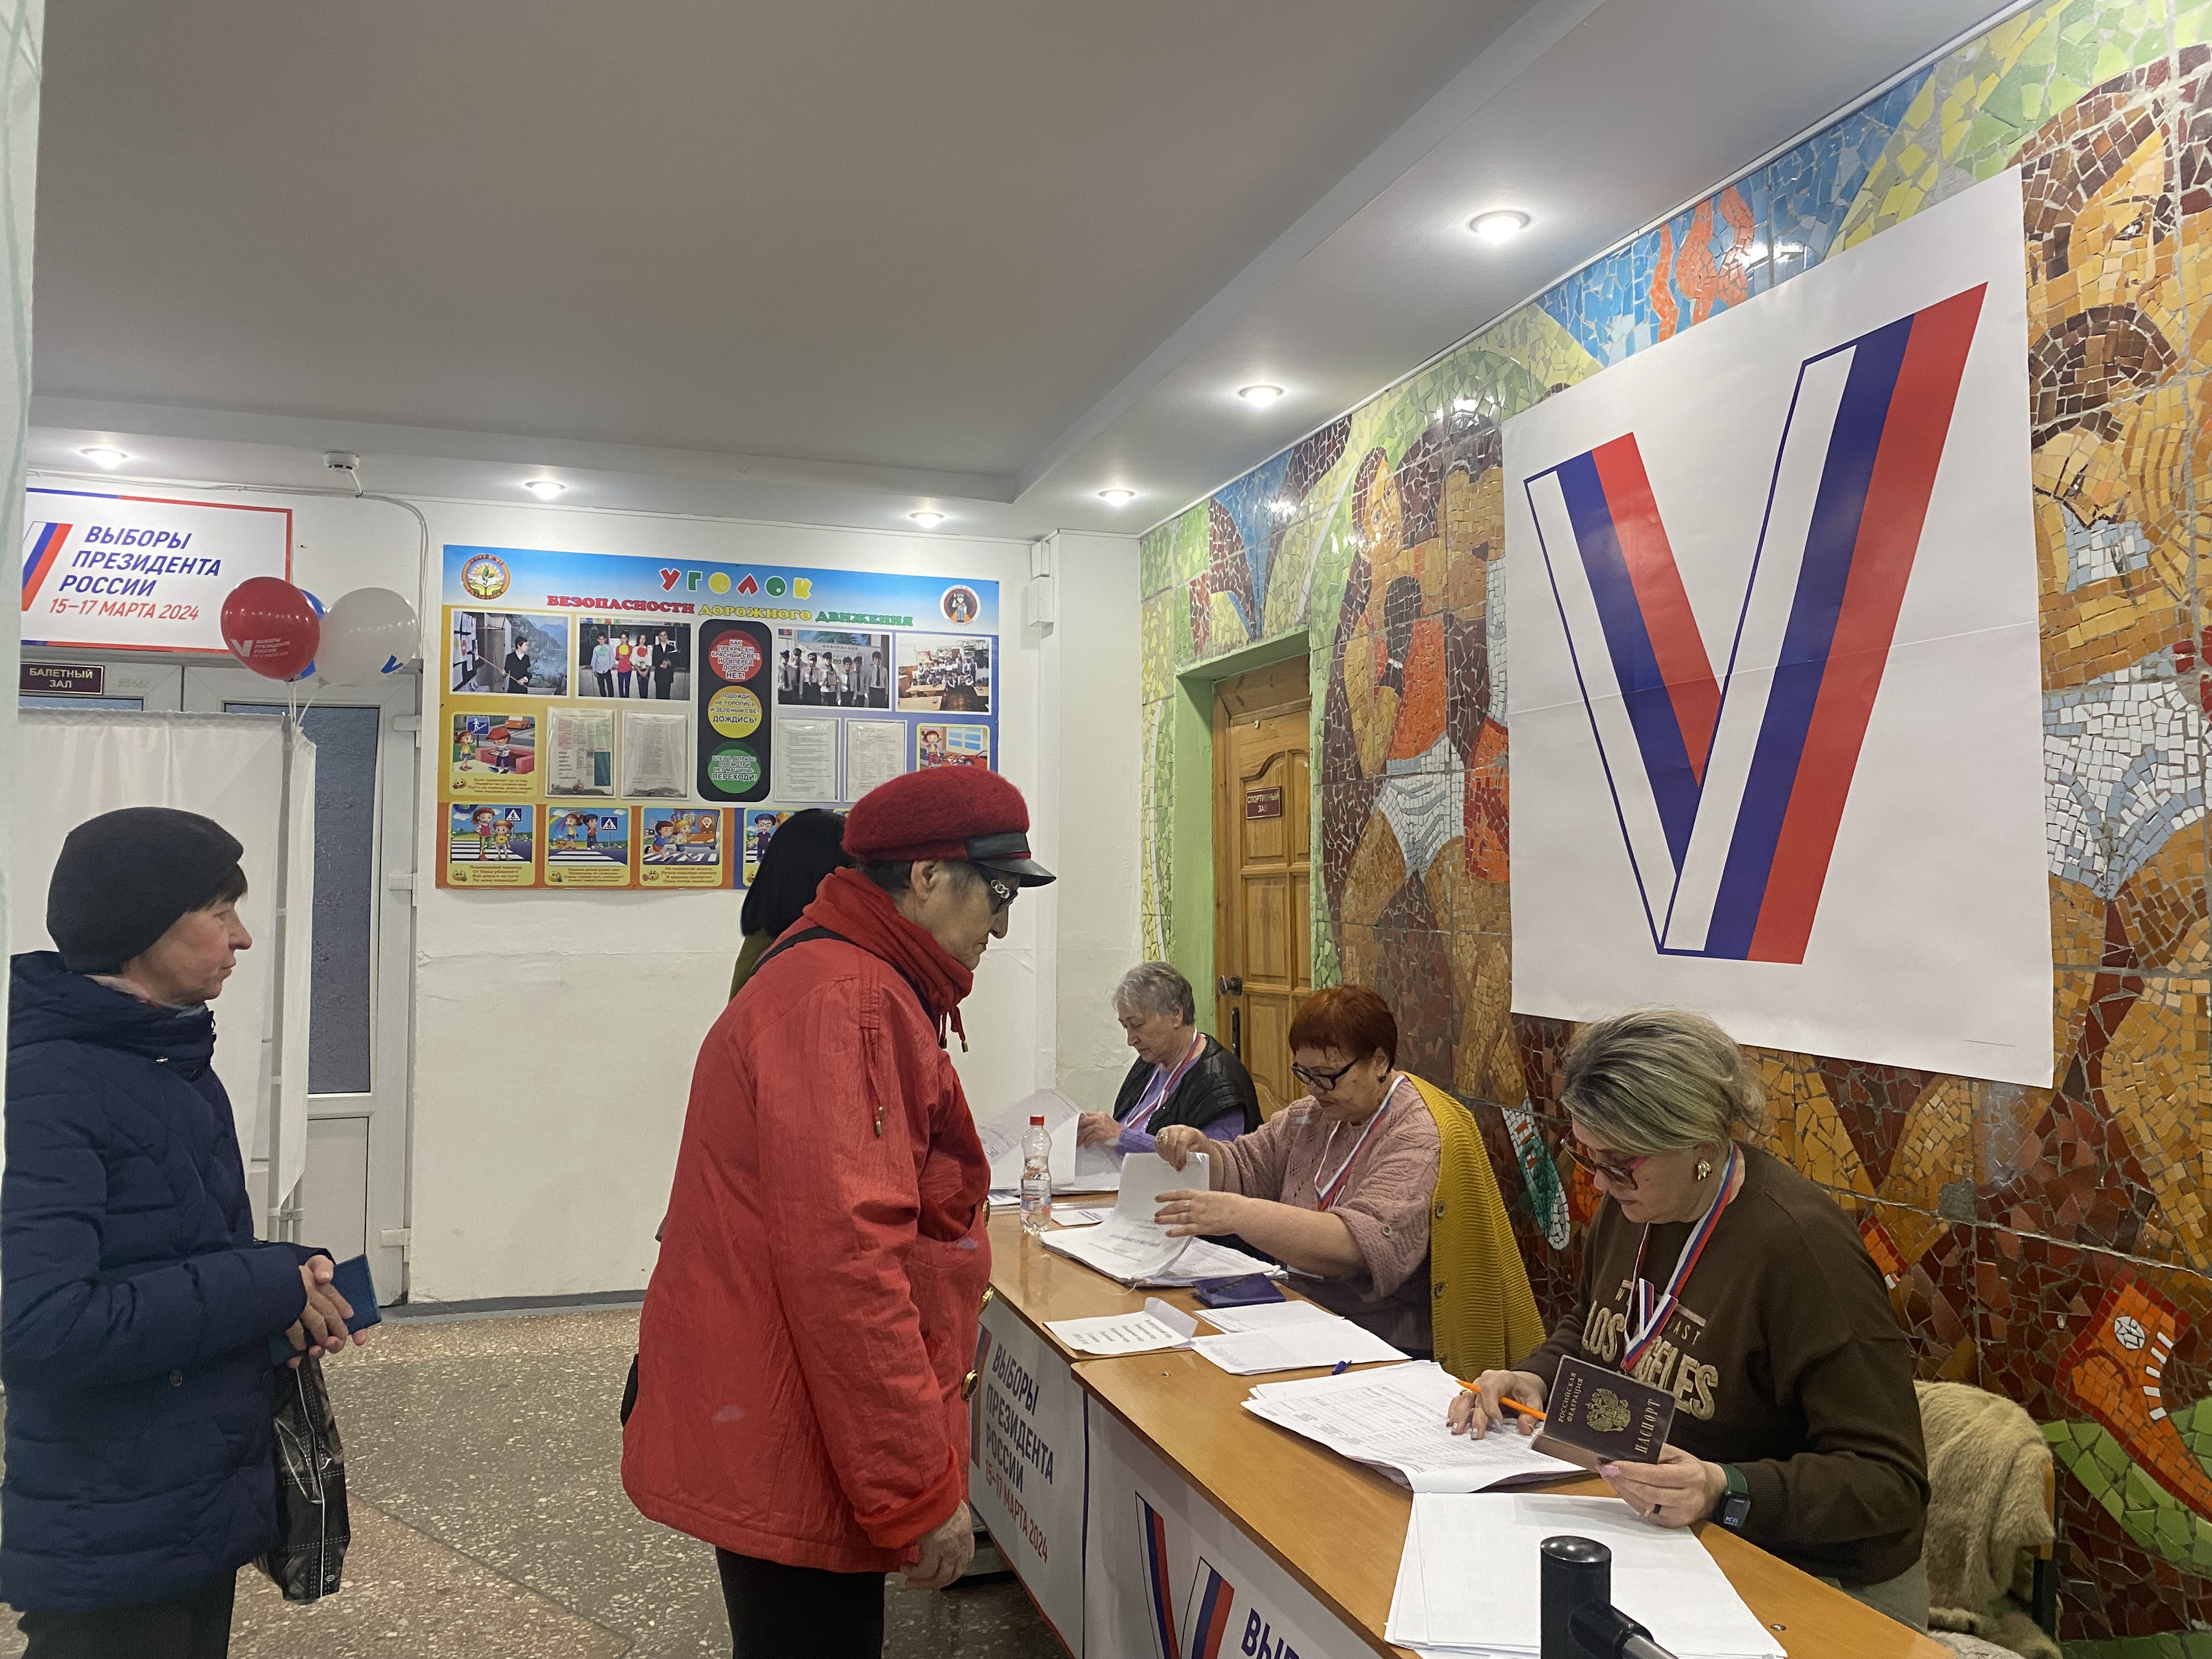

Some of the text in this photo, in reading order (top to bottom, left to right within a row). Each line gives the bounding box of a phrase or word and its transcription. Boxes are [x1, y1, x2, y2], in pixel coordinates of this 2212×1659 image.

[84, 526, 193, 549] ВЫБОРЫ
[71, 550, 221, 576] ПРЕЗИДЕНТА
[58, 574, 157, 596] РОССИИ
[659, 567, 813, 600] УГОЛОК
[98, 601, 156, 618] МАРТА
[159, 604, 199, 620] 2024
[546, 595, 913, 627] БЕЗОПАСНОСТИ ДОРОЖНОГО ДВИЖЕНИЯ
[29, 668, 93, 679] БАЛЕТНЫЙ
[49, 680, 72, 689] ЗАЛ
[1582, 1300, 1626, 1363] LOS
[1668, 1318, 1701, 1346] AST
[992, 1342, 1040, 1417] ВЫБОРЫ
[1558, 1372, 1577, 1423] РОССИЙСКАЯ
[1566, 1378, 1584, 1423] ФЕДЕРАЦИЯ
[986, 1382, 1054, 1486] ПРЕЗИДЕНТА
[1634, 1398, 1661, 1454] ПАСПОРТ
[986, 1422, 1024, 1493] РОССИИ
[1003, 1483, 1028, 1537] МАРТА
[1029, 1518, 1048, 1564] 2024
[1241, 1607, 1300, 1659] ВЫ
